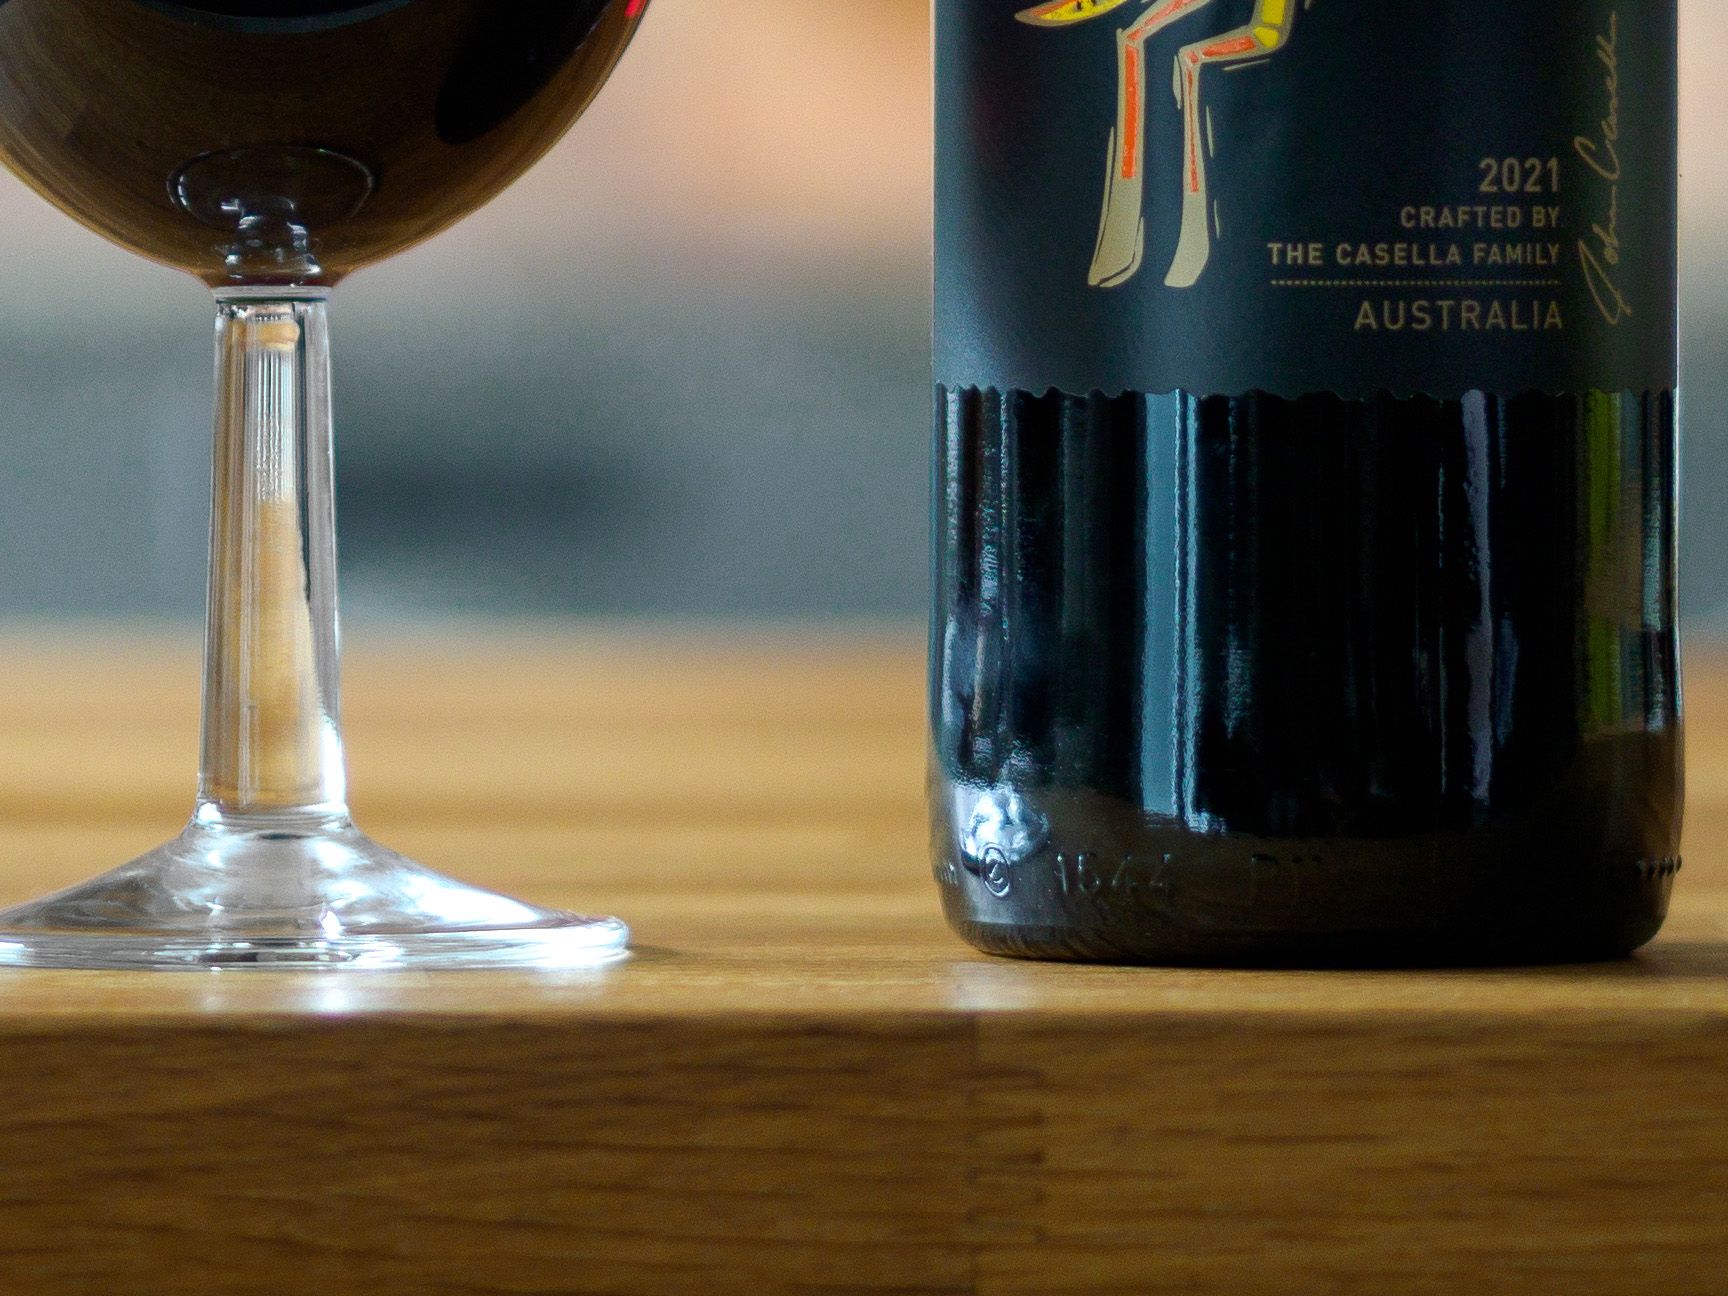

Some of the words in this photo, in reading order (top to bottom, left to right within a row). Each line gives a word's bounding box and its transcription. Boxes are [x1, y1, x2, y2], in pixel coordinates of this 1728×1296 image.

[1478, 157, 1561, 193] 2021
[1400, 207, 1521, 228] CRAFTED
[1532, 207, 1561, 228] BY
[1267, 243, 1323, 266] THE
[1336, 243, 1462, 266] CASELLA
[1472, 244, 1561, 264] FAMILY
[1353, 300, 1563, 331] AUSTRALIA
